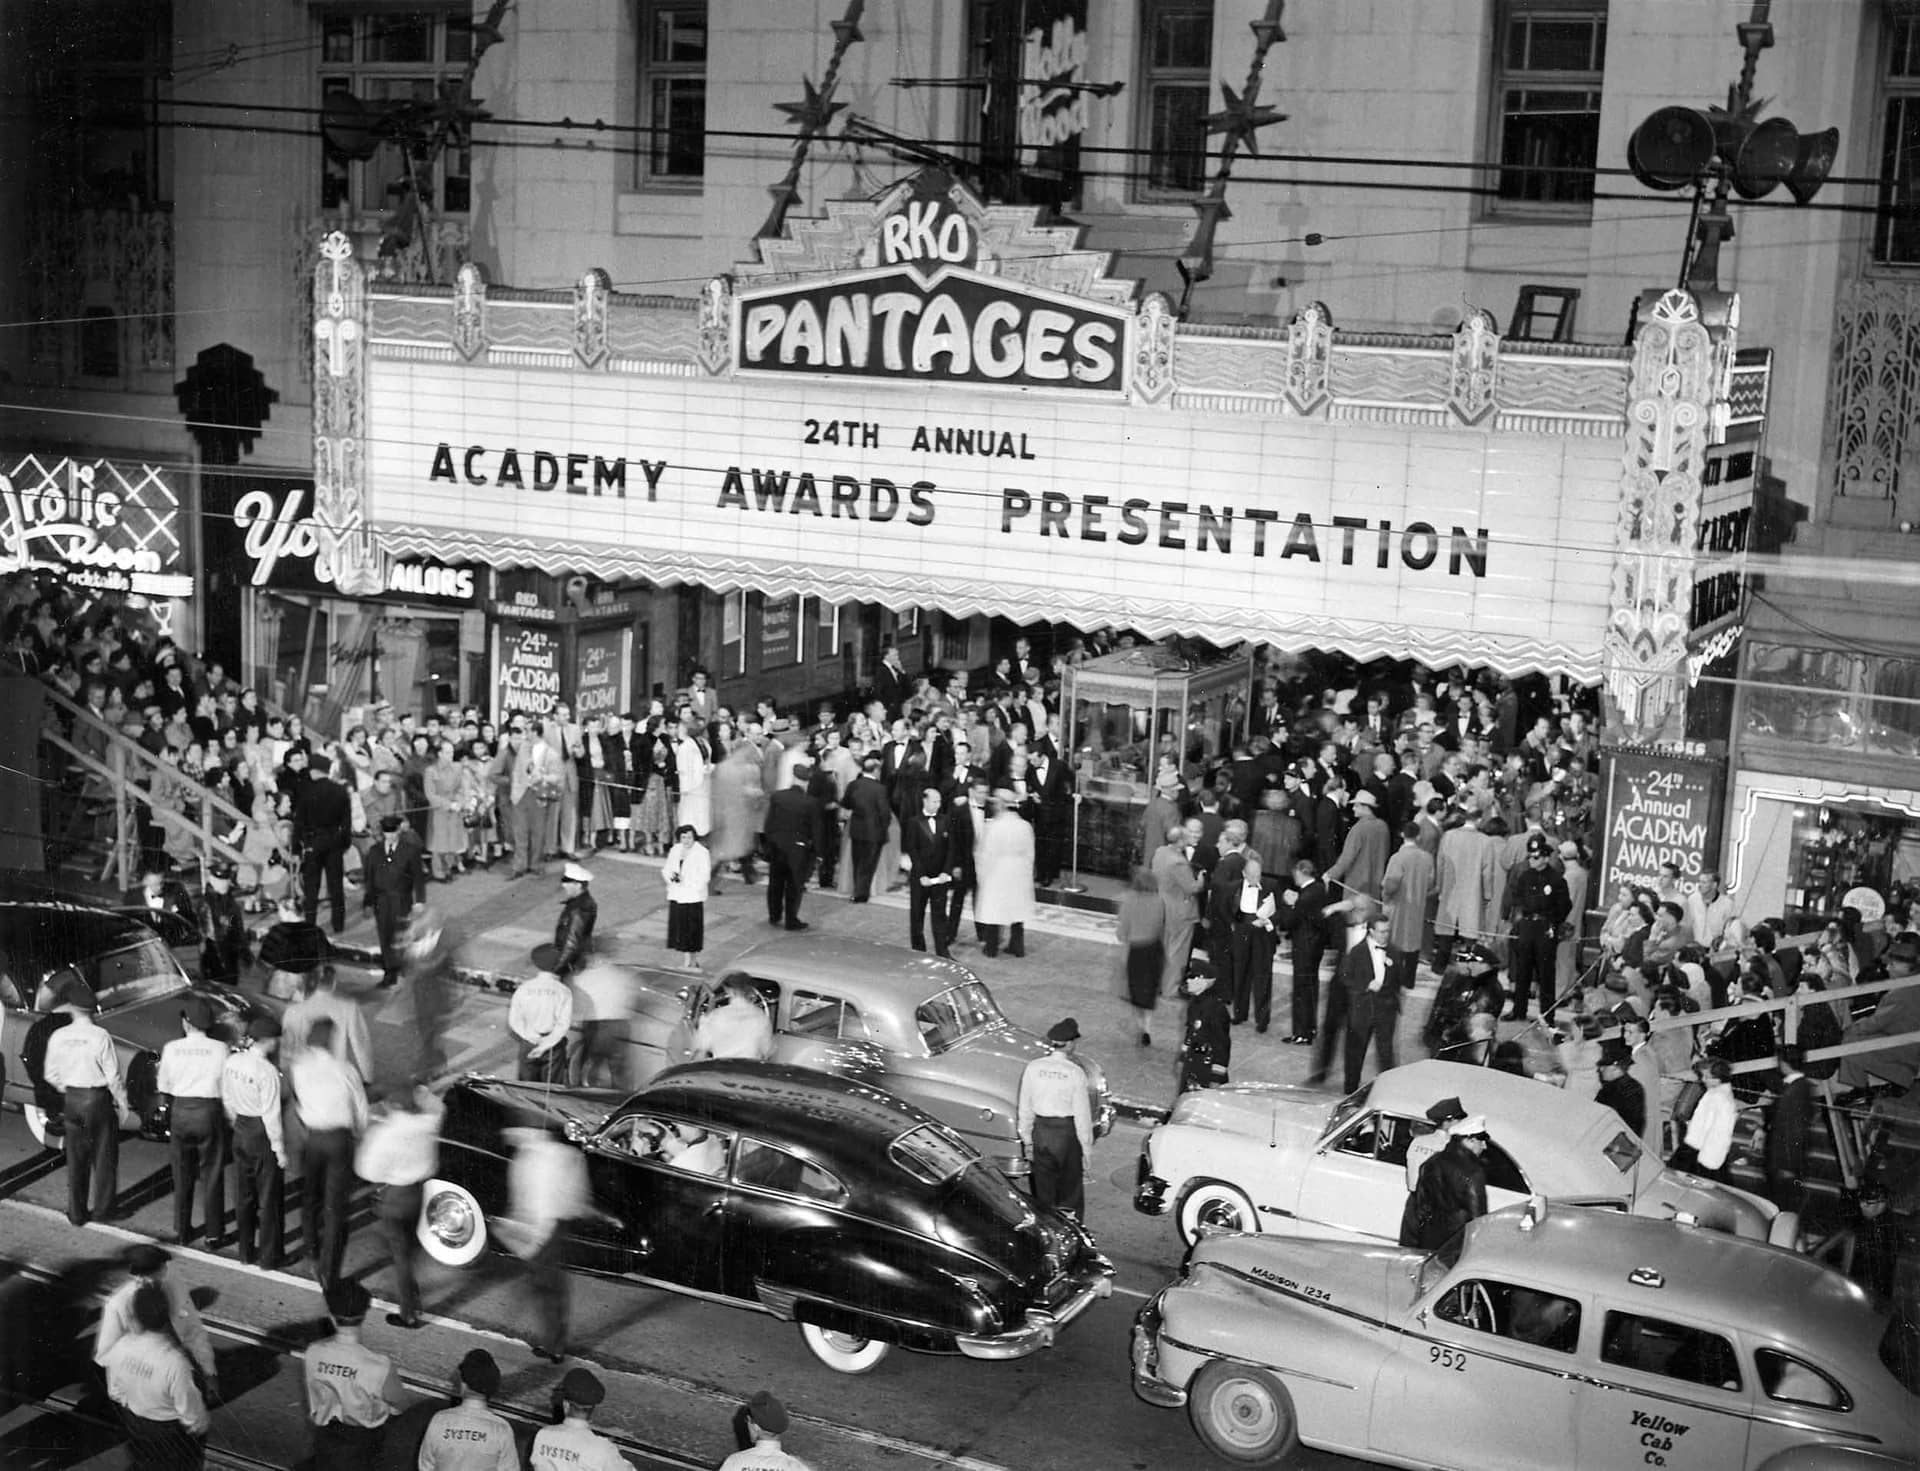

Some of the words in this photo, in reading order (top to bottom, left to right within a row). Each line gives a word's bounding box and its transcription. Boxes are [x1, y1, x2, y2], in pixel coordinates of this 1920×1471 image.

[883, 200, 970, 265] RKO
[745, 293, 1117, 383] PANTAGES
[804, 418, 880, 449] 24TH
[912, 425, 1036, 461] ANNUAL
[429, 442, 667, 502] ACADEMY
[717, 466, 936, 527] AWARDS
[1001, 487, 1489, 578] PRESENTATION
[390, 563, 474, 599] AILORS
[512, 646, 553, 669] Annual
[1631, 789, 1692, 820] Annual
[1612, 810, 1707, 849] ACADEMY
[1616, 839, 1702, 875] AWARDS
[1250, 1266, 1300, 1289] MADISON
[1304, 1286, 1331, 1301] 1234
[317, 1361, 358, 1380] SYSTEM
[1430, 1346, 1467, 1372] 952
[443, 1428, 487, 1442] SYSTEM
[1630, 1410, 1690, 1437] Yellow
[539, 1444, 580, 1462] SYSTEM
[1640, 1432, 1673, 1452] Cab
[1644, 1451, 1667, 1467] Co.
